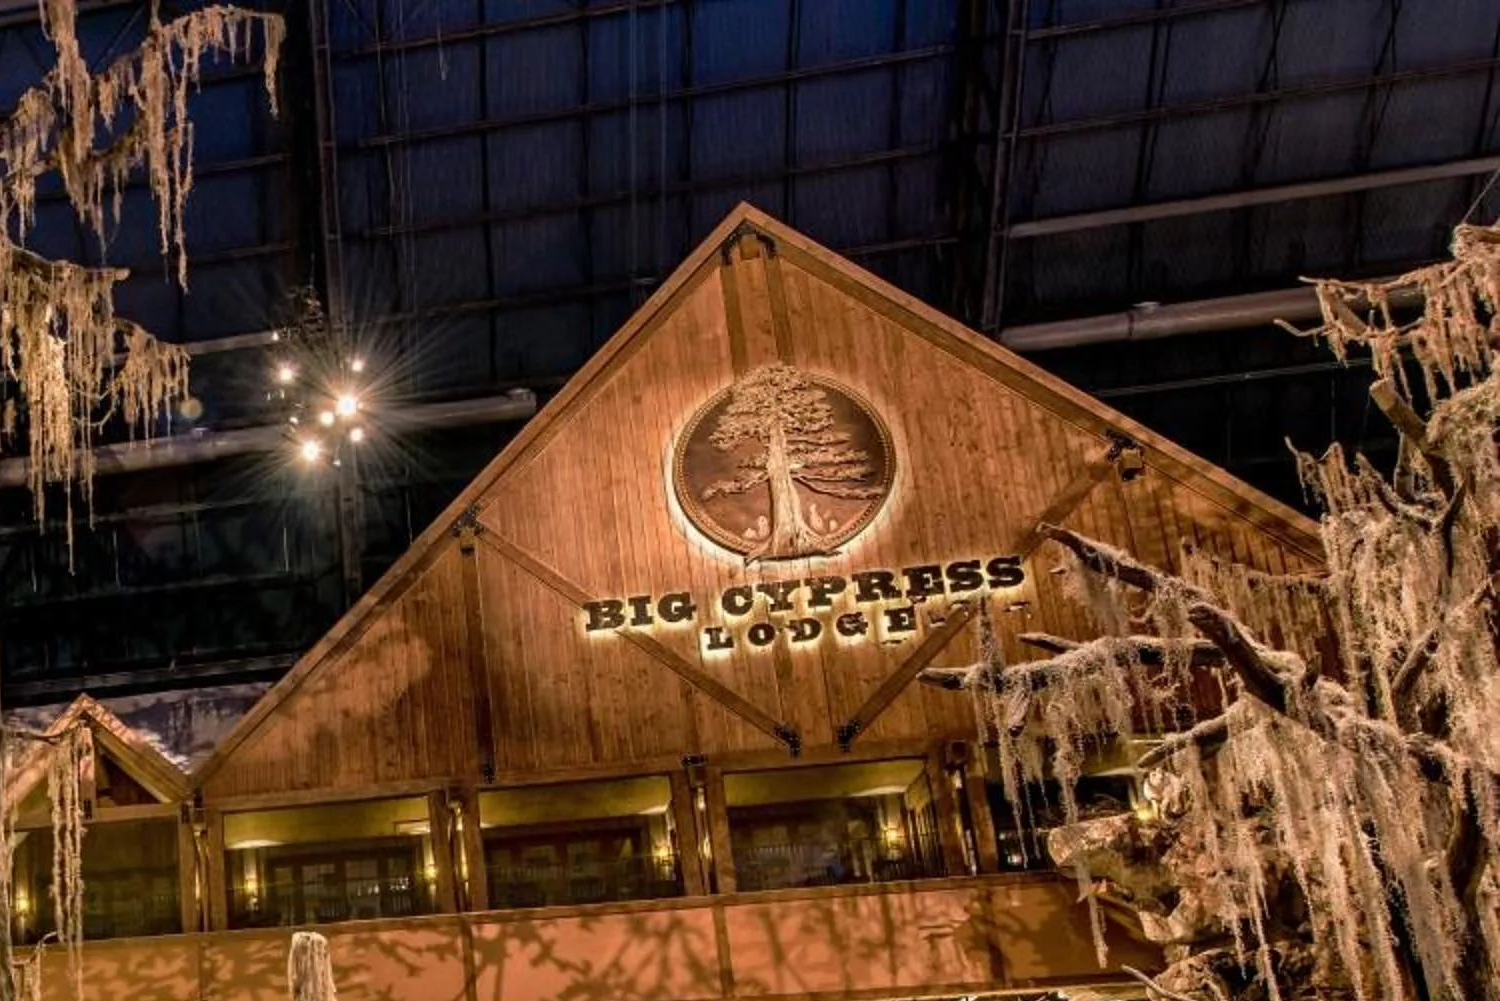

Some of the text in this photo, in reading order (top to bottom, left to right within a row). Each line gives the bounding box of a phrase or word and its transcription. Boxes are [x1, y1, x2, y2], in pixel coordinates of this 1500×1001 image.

[583, 555, 1025, 632] BIG CYPRESS
[703, 607, 916, 651] LODGE
